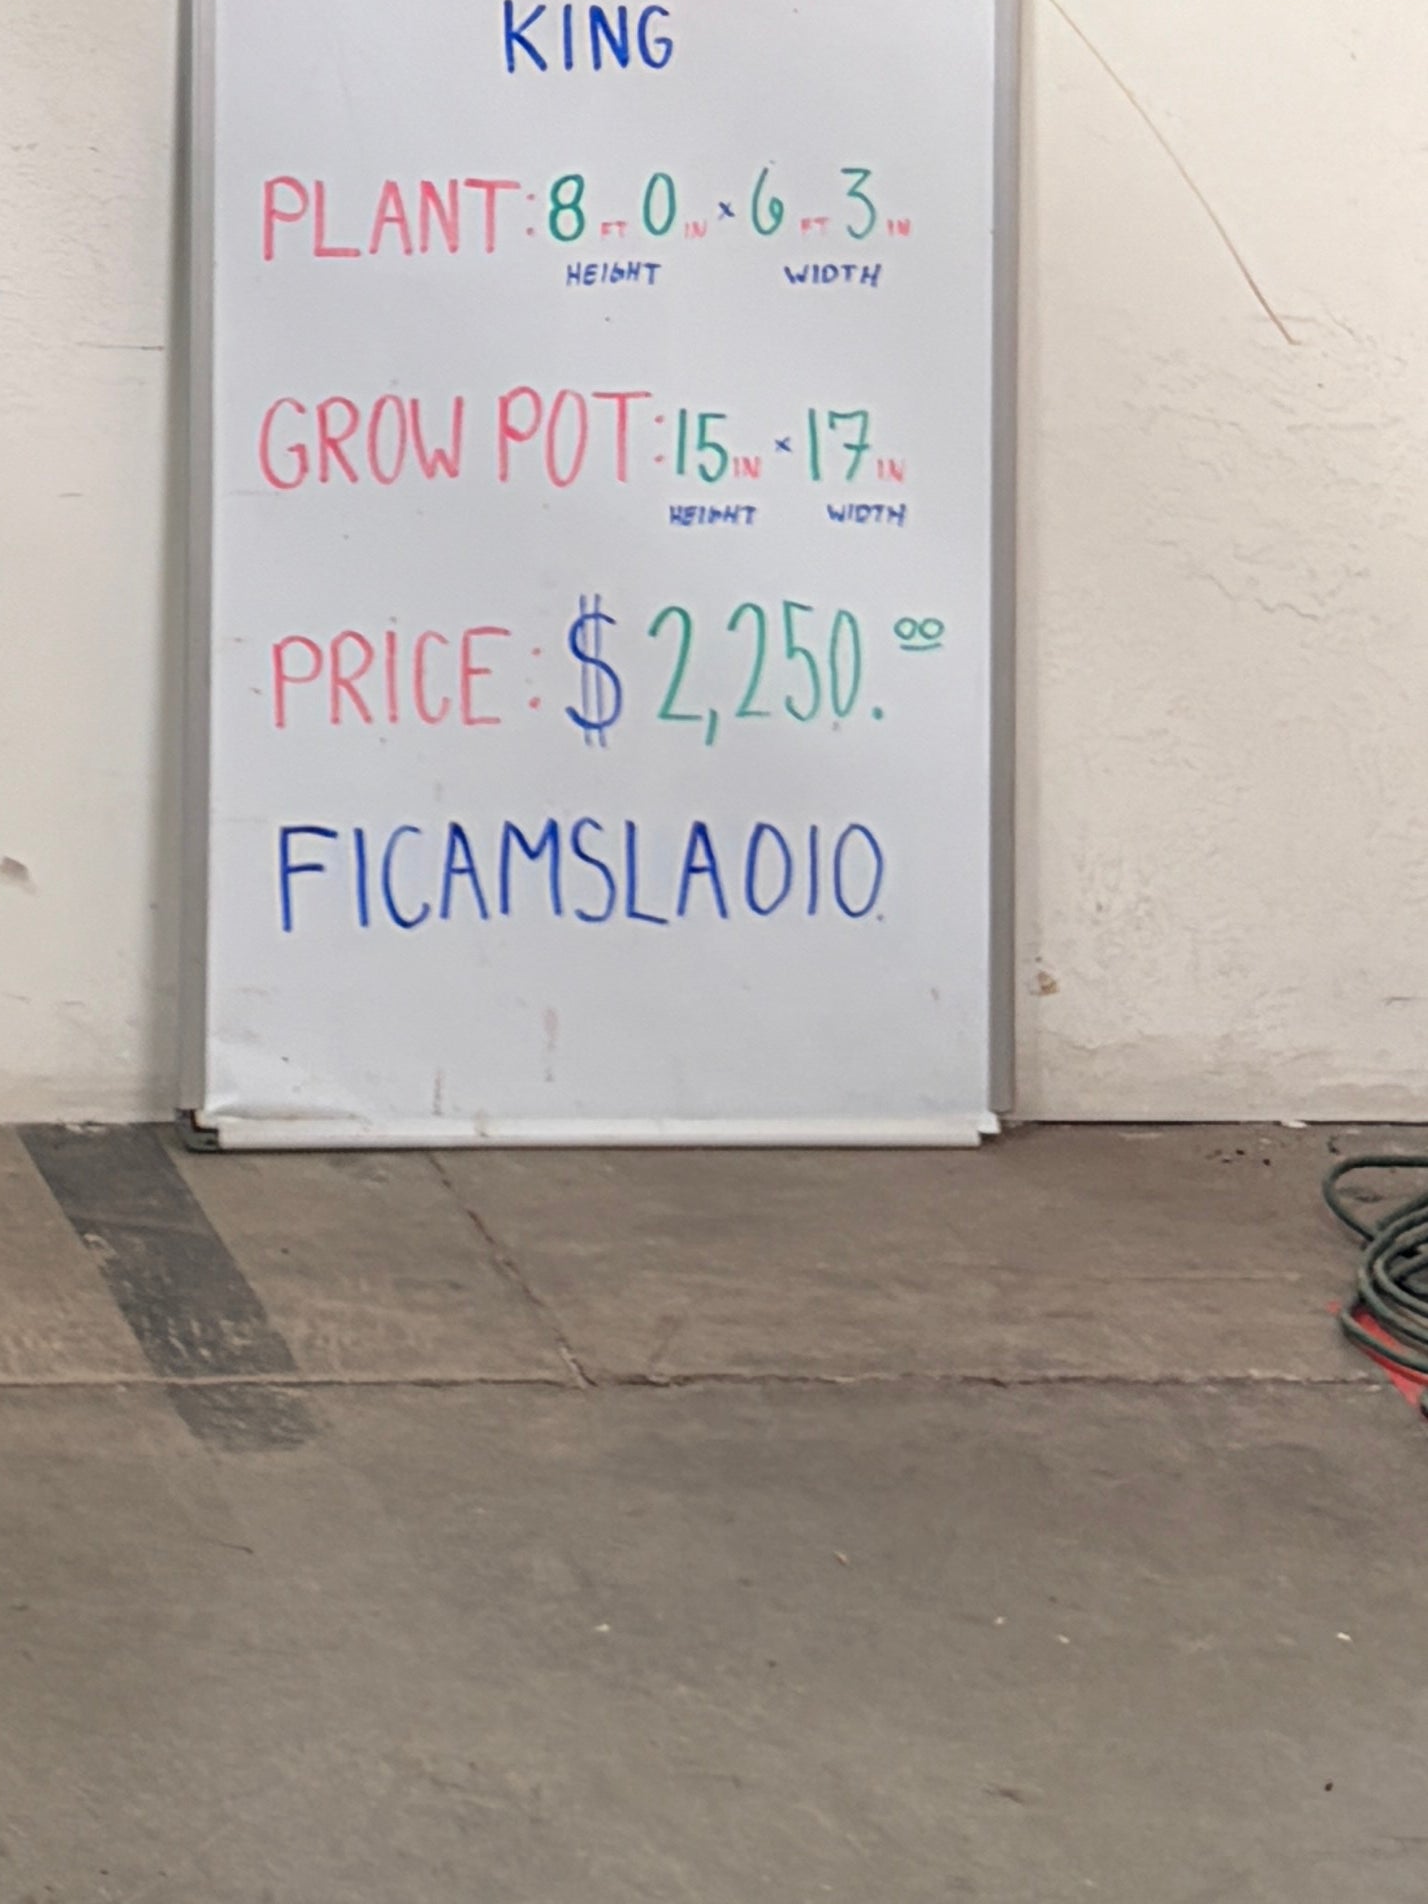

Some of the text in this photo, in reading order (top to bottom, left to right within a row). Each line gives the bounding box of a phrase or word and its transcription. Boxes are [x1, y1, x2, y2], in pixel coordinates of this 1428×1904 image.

[262, 175, 536, 262] PLANT:
[565, 260, 884, 289] HEIGHT WIDTH
[258, 393, 465, 491] GROW
[497, 385, 665, 489] POT:
[668, 502, 908, 529] HEIGHT WIDTH
[271, 625, 542, 730] PRICE:
